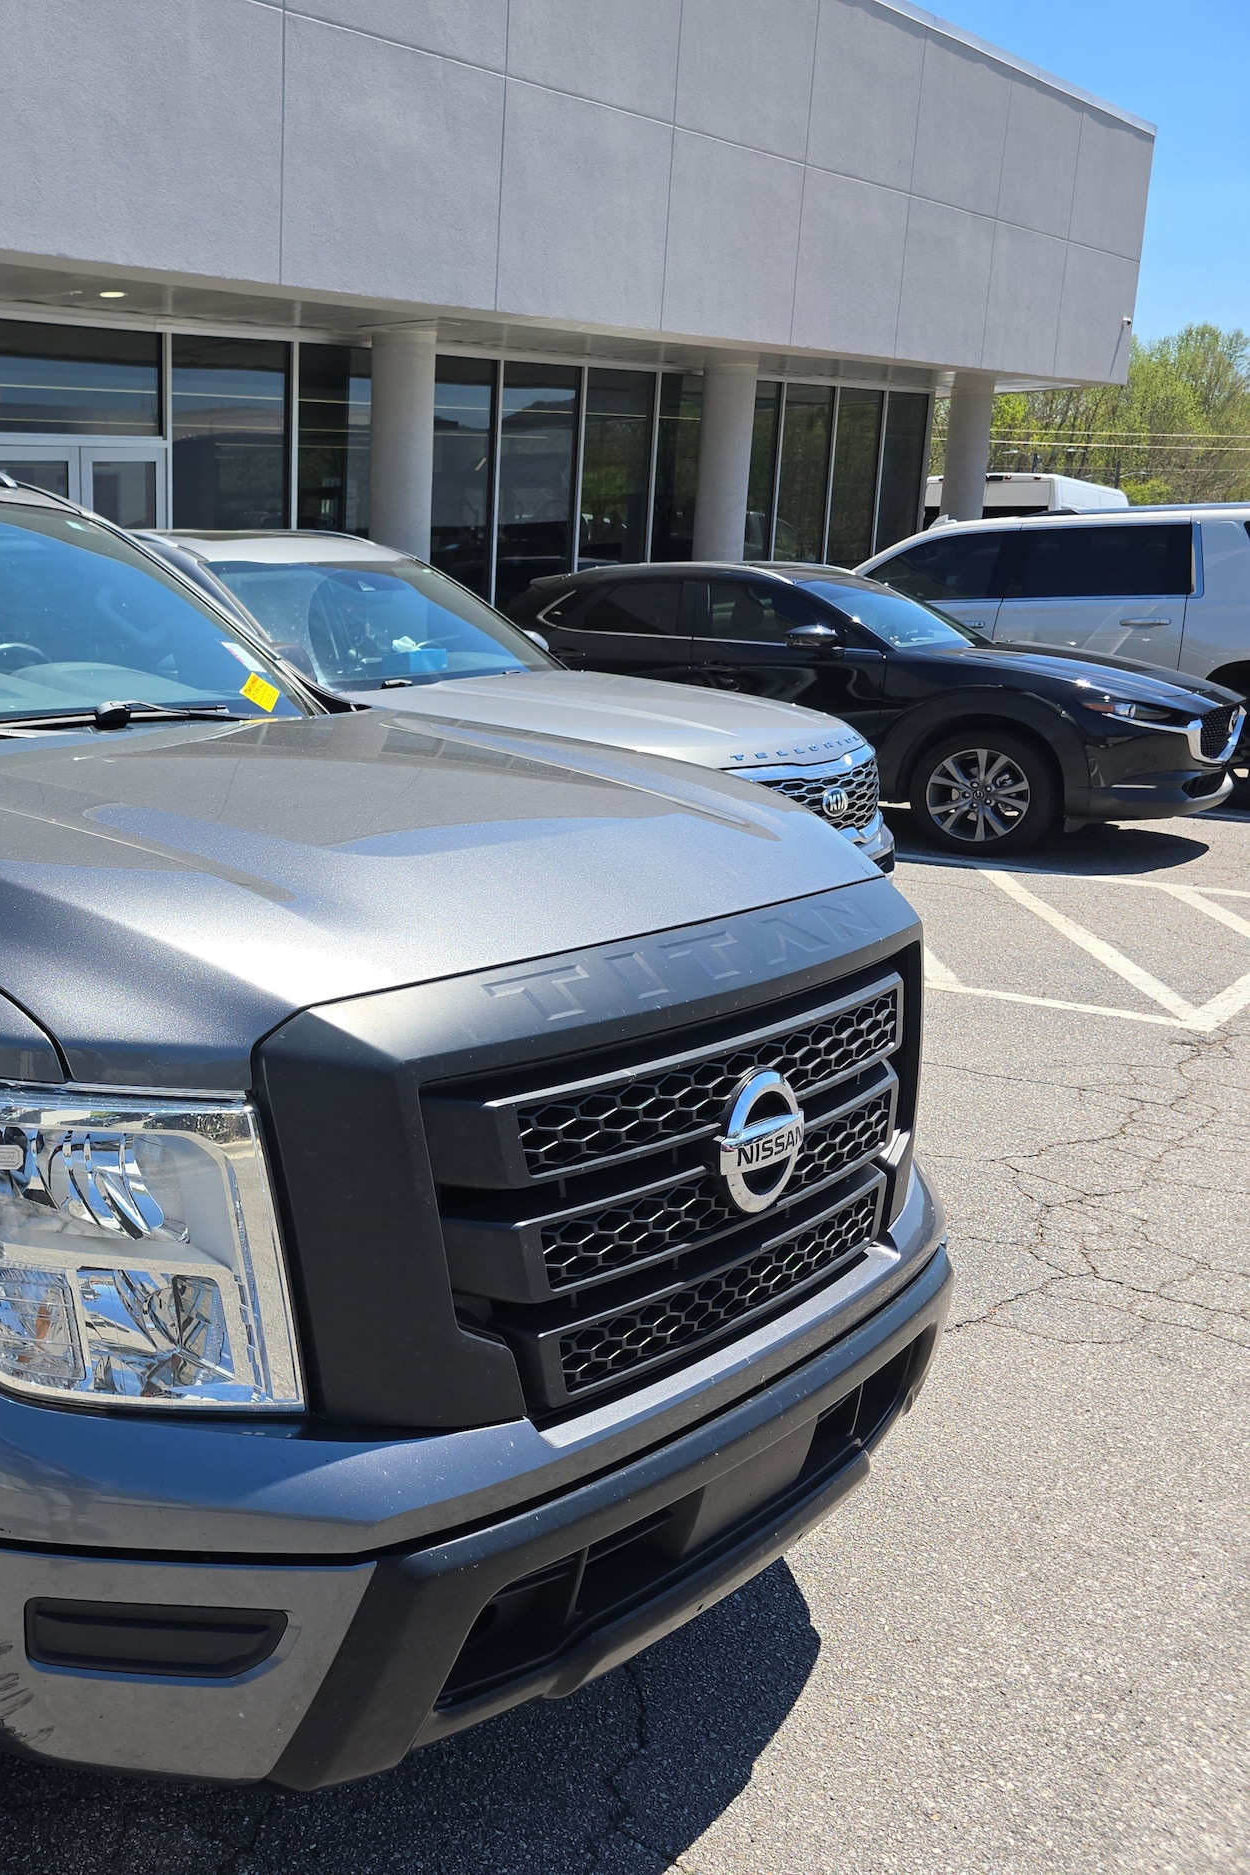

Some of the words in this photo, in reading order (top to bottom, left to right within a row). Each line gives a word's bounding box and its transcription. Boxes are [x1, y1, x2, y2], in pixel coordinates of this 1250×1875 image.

[828, 793, 846, 811] KIA
[480, 904, 882, 1021] TITAN
[737, 1122, 804, 1167] NISSAN
